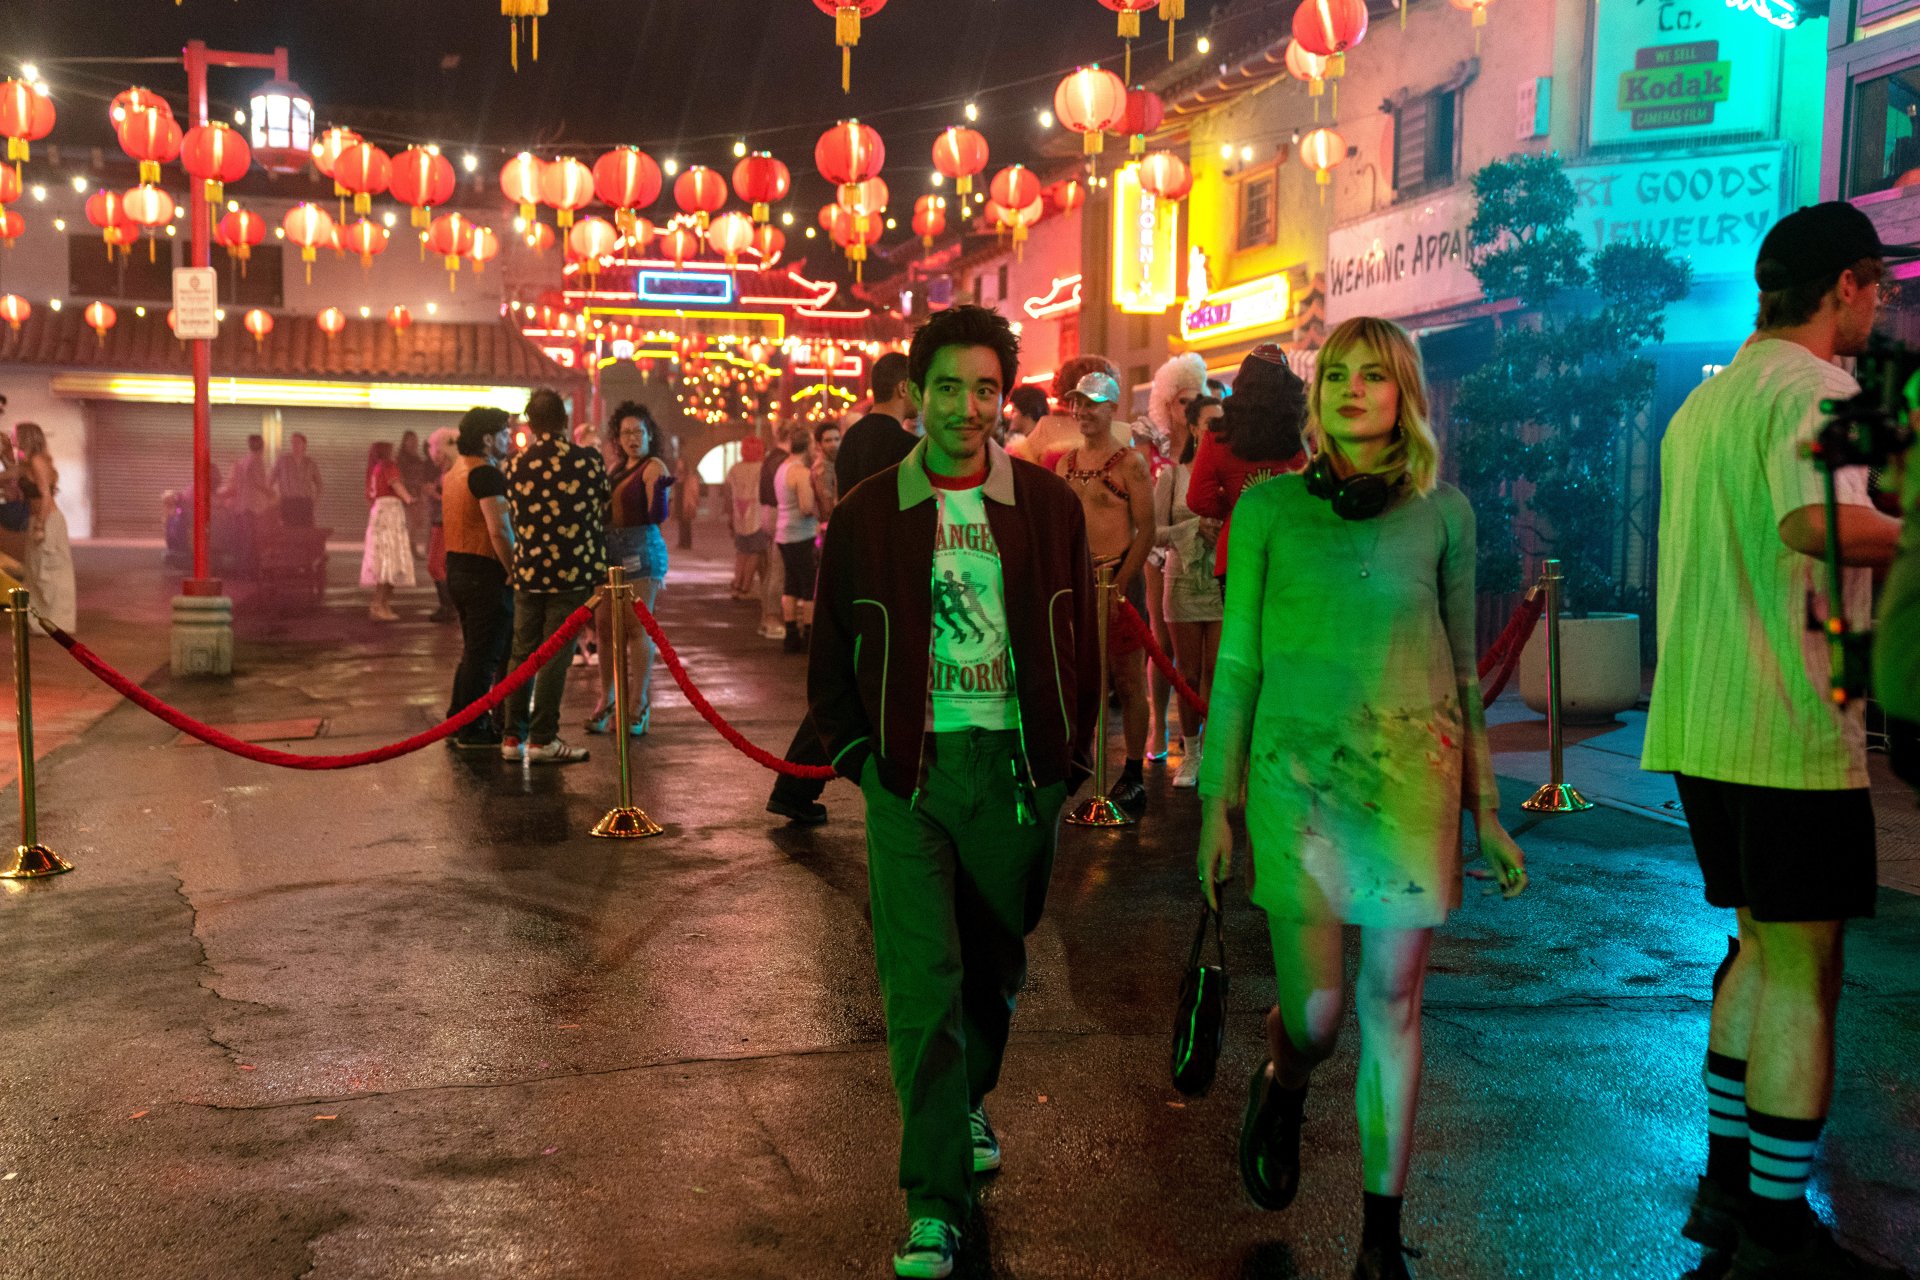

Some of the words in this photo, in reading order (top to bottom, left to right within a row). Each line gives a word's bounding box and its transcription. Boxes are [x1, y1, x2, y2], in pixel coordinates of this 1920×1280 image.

[1654, 50, 1671, 63] WE
[1674, 48, 1697, 61] SELL
[1625, 70, 1724, 103] Kodak
[1574, 174, 1623, 209] RT
[1635, 163, 1773, 205] GOODS
[1139, 188, 1156, 298] HOENIX
[1592, 209, 1770, 253] JEWELRY
[1330, 243, 1406, 297] WEARING
[1411, 229, 1475, 276] APPAR
[935, 523, 998, 553] ANGE
